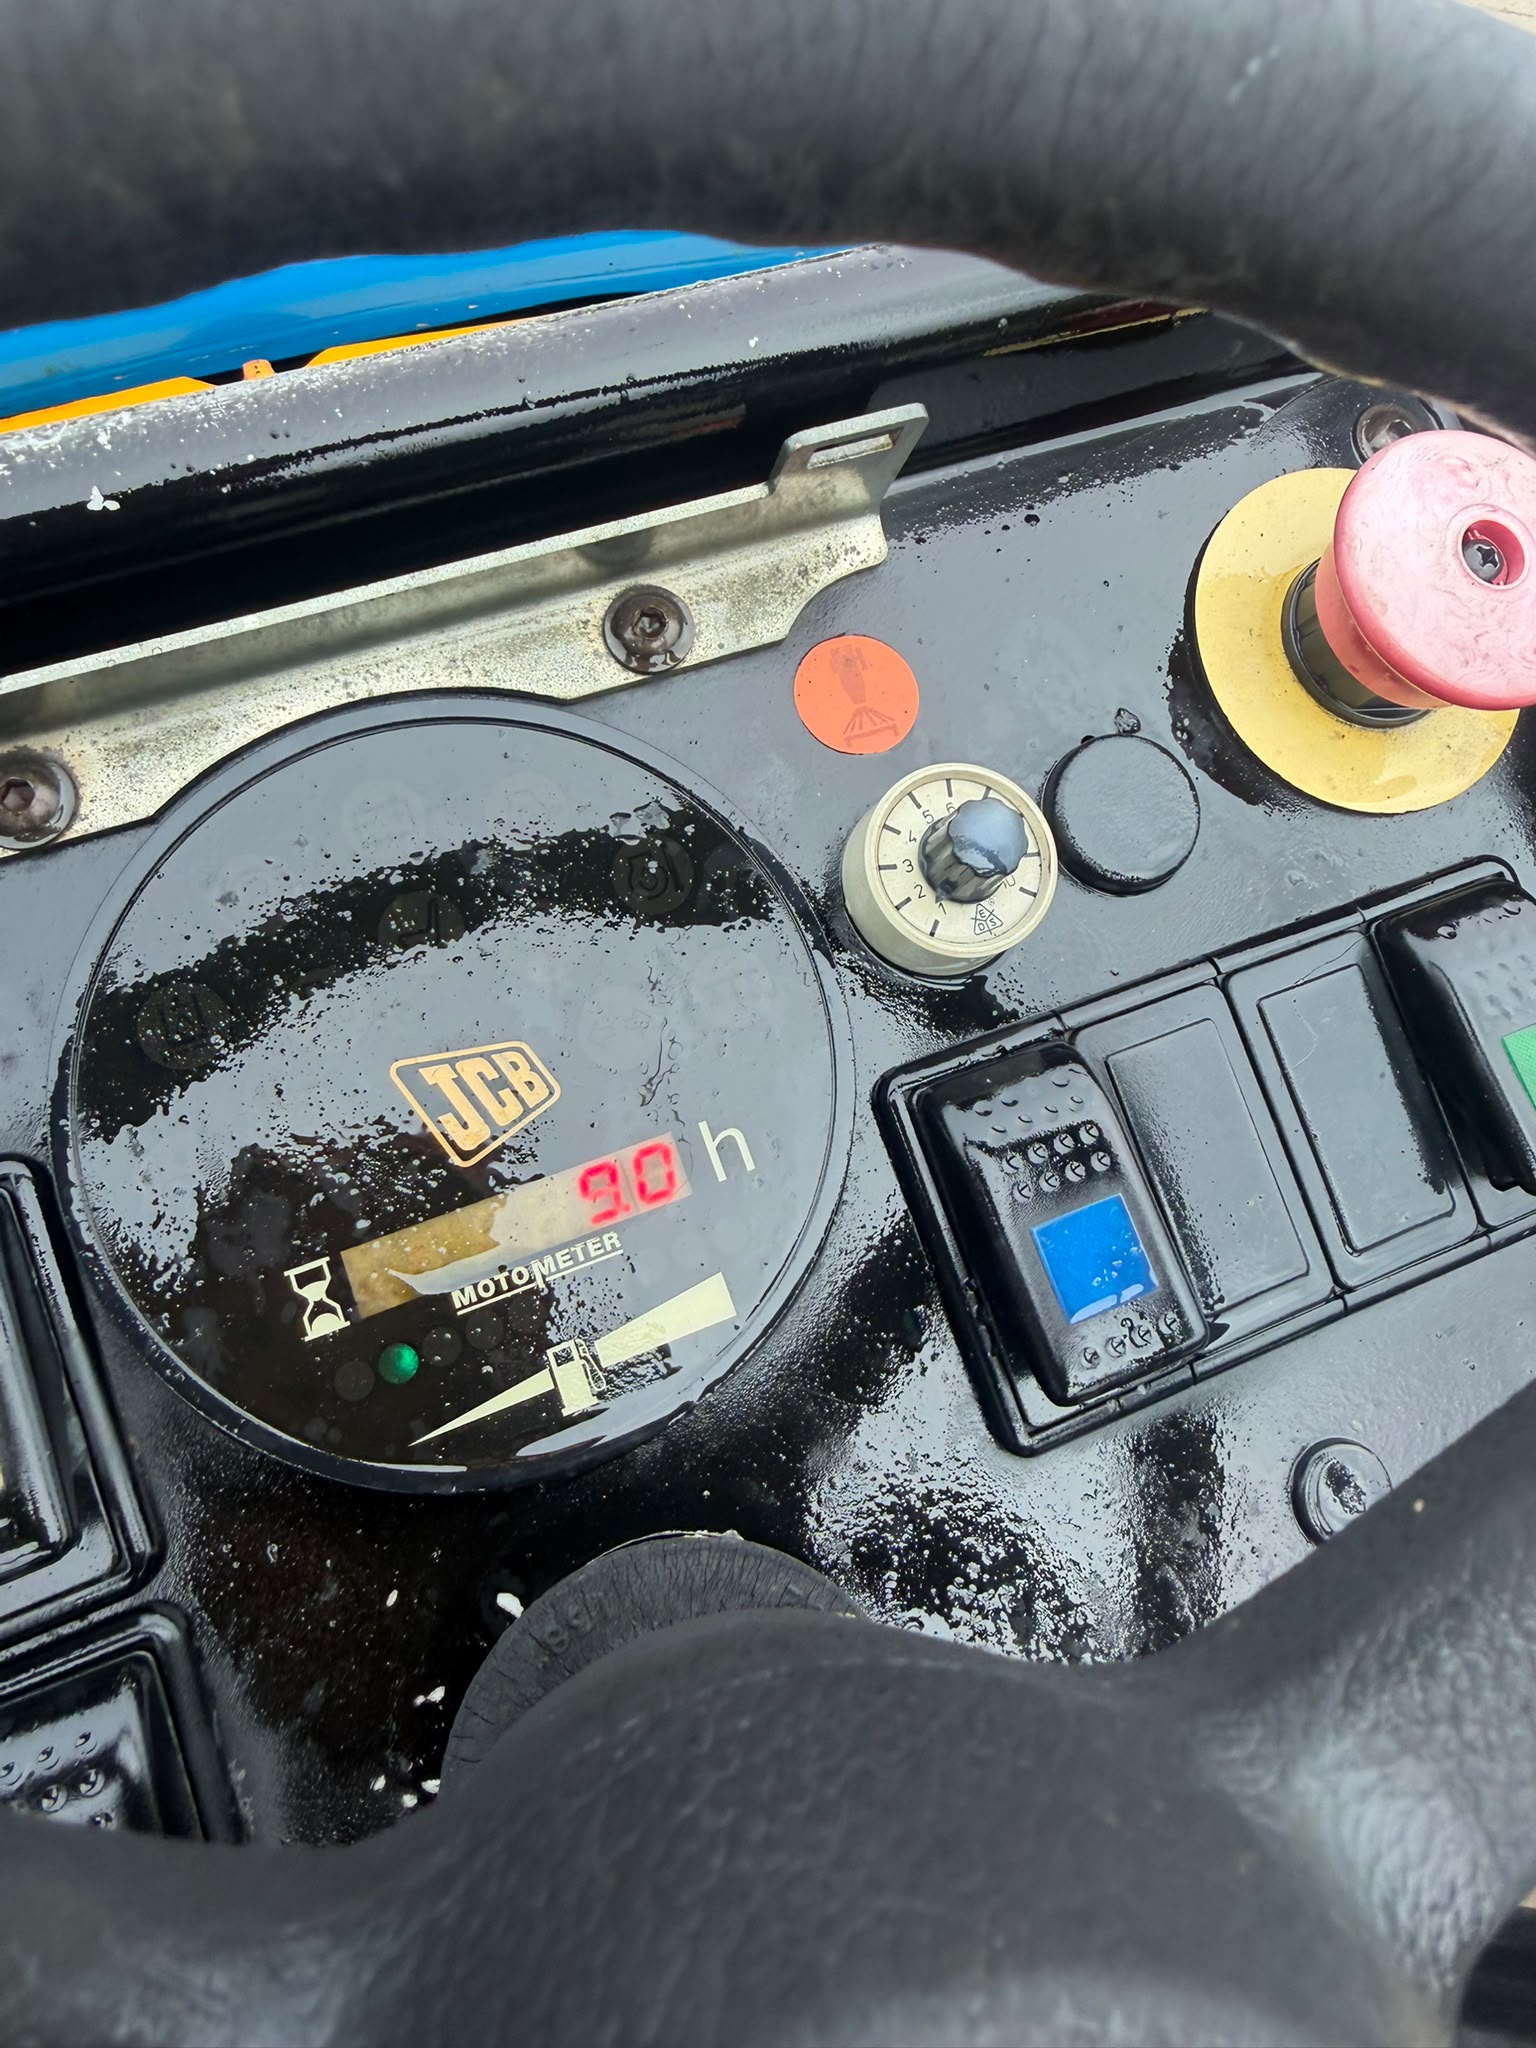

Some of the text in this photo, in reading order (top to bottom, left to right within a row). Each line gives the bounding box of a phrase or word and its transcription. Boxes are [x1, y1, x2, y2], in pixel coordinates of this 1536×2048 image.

[922, 809, 935, 825] 5
[908, 830, 917, 843] 4
[902, 858, 914, 873] 3
[913, 884, 927, 899] 2
[938, 901, 947, 915] 1
[418, 1051, 550, 1151] JCB
[698, 1119, 756, 1183] h
[450, 1230, 622, 1310] MOTOMETER
